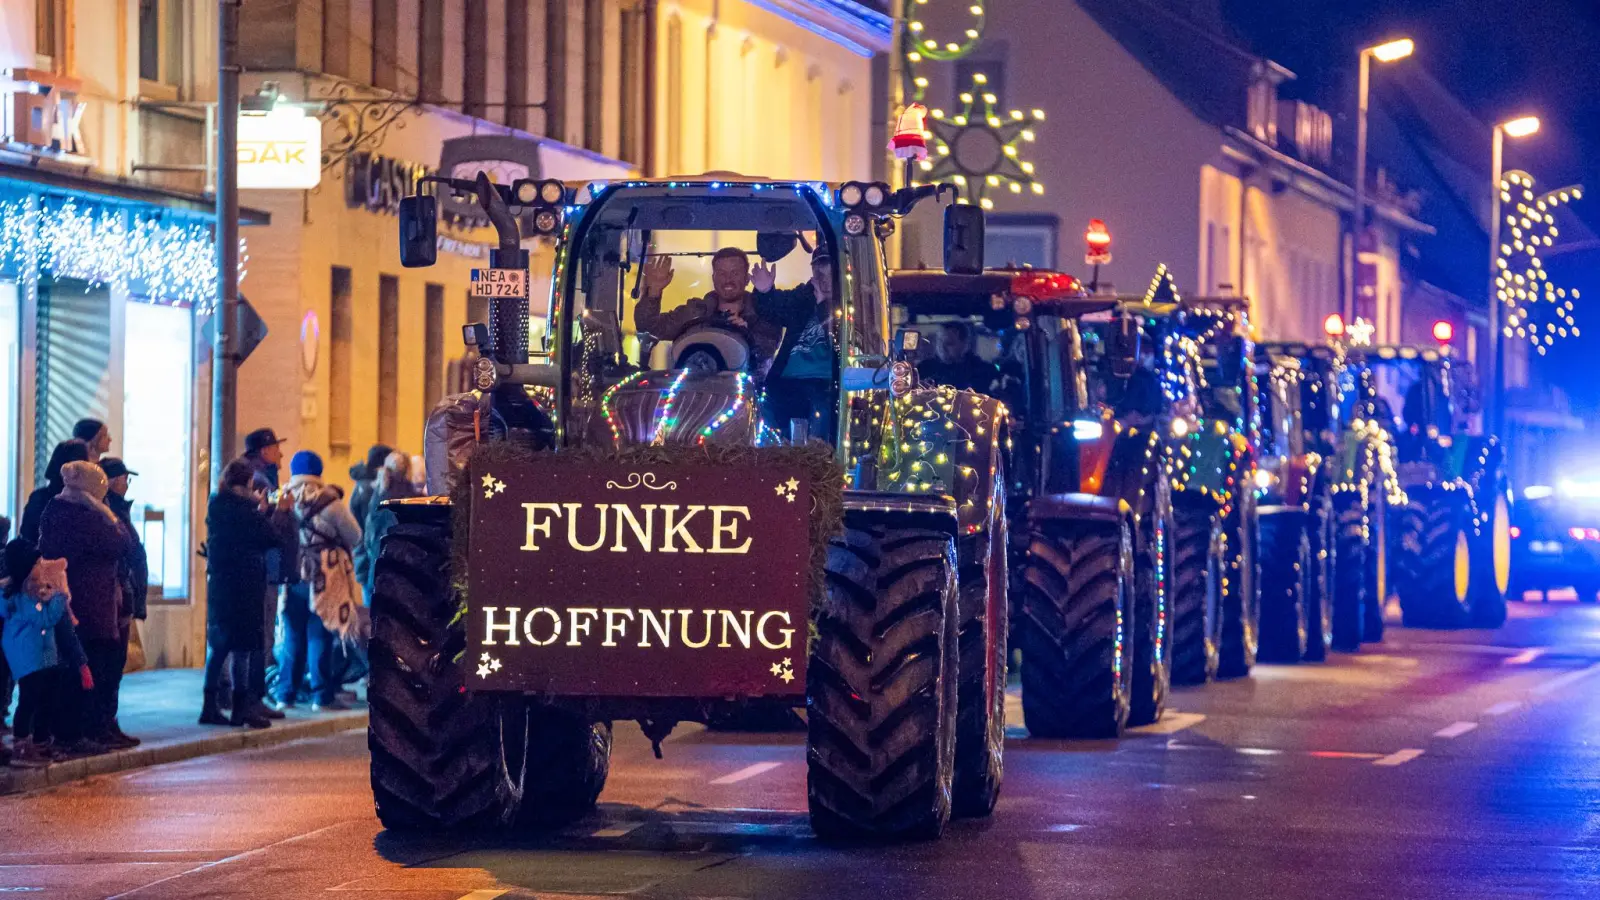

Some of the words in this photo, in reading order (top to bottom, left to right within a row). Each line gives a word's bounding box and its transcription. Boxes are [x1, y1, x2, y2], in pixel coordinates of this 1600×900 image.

[238, 141, 305, 164] DAK
[481, 271, 506, 282] NEA
[476, 284, 493, 296] HD
[496, 284, 519, 296] 724
[520, 502, 753, 554] FUNKE
[481, 606, 796, 649] HOFFNUNG
